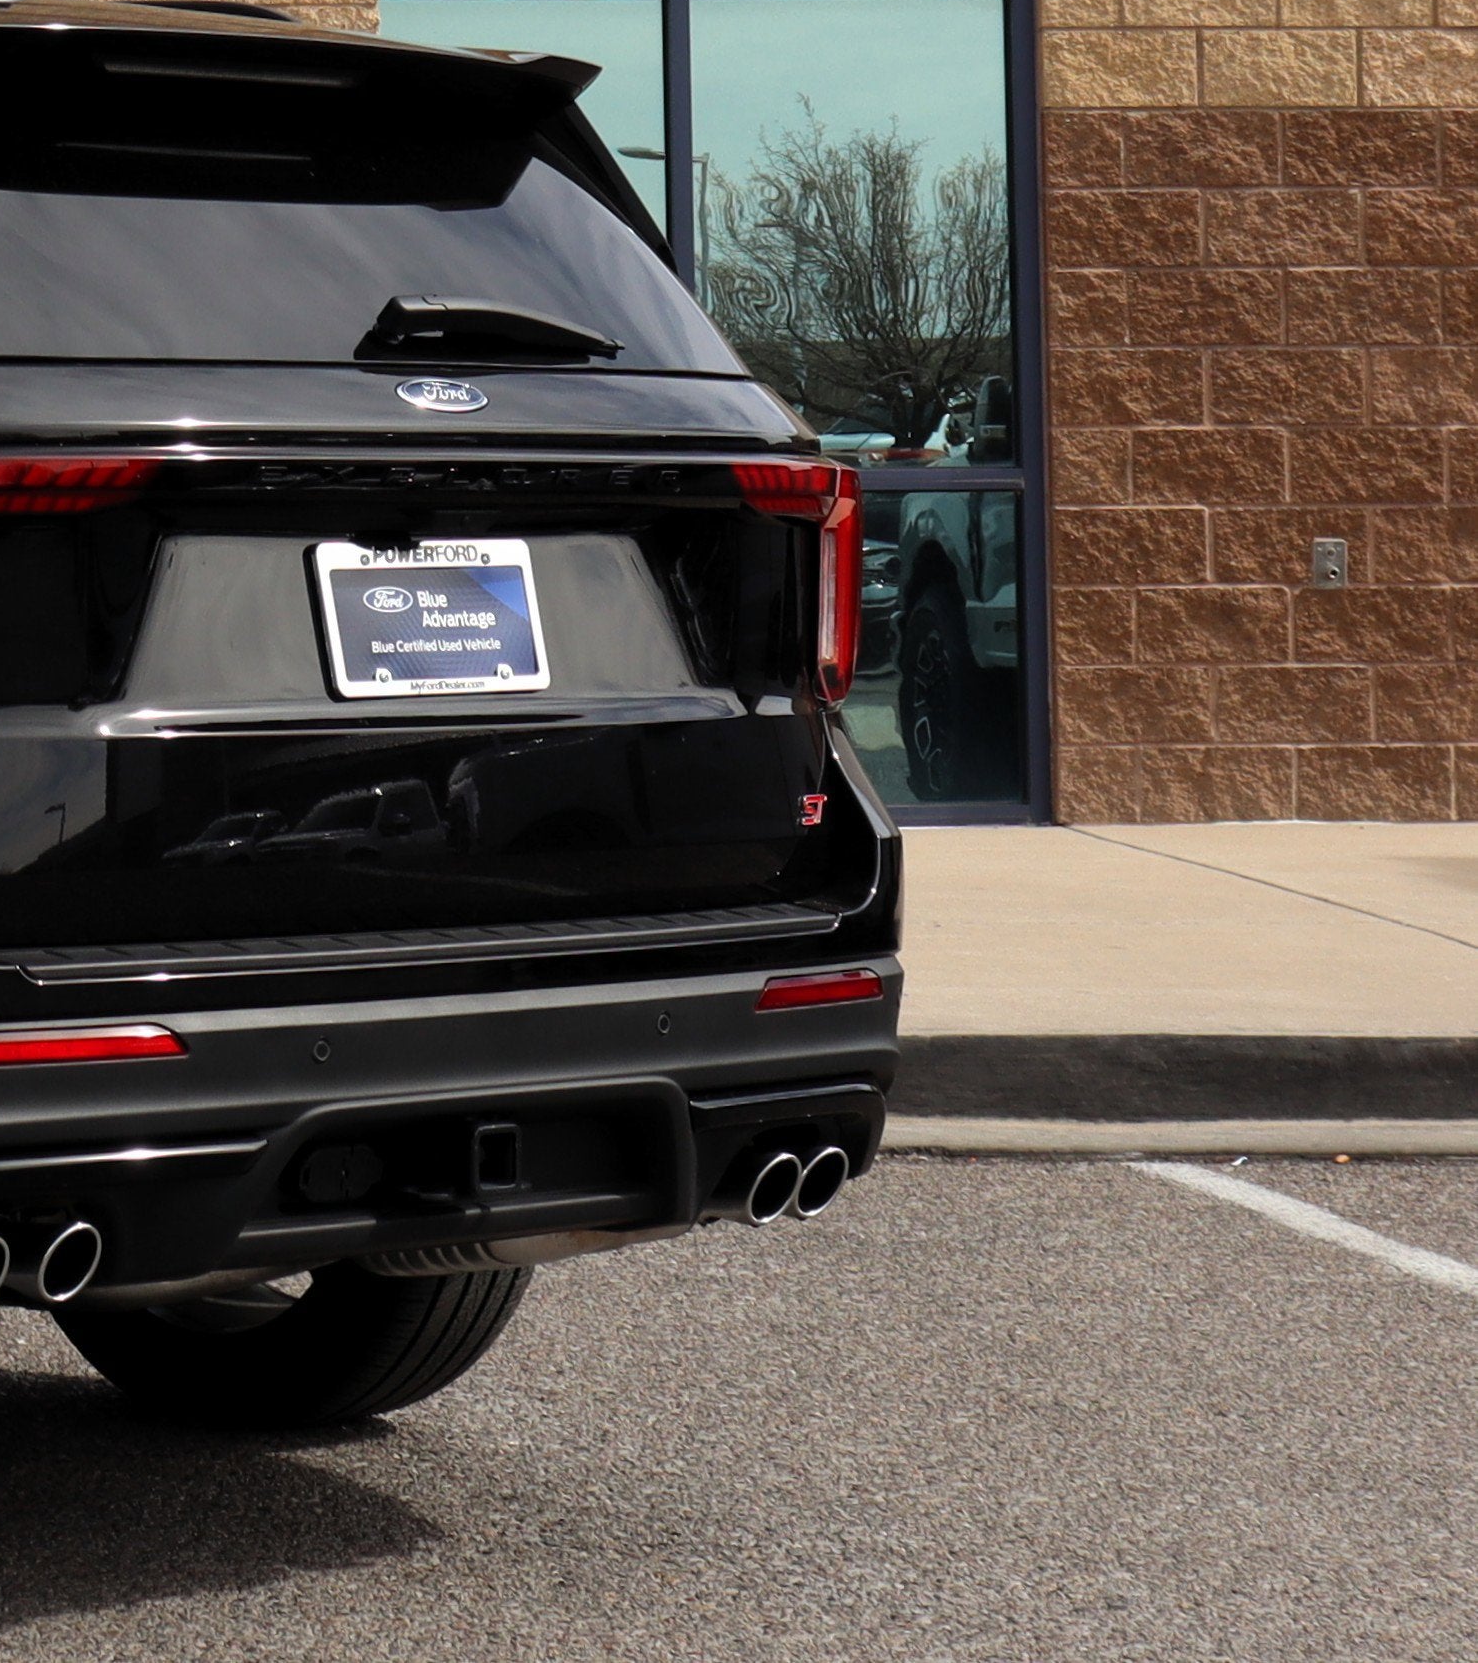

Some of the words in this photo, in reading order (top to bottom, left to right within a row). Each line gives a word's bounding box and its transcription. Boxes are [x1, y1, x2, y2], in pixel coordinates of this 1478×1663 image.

[423, 382, 471, 401] Ford
[372, 544, 478, 564] POWERFORD
[373, 590, 404, 608] Ford
[417, 590, 448, 608] Blue
[422, 610, 496, 629] Advantage
[371, 640, 395, 654] Blue
[396, 639, 437, 652] Certified
[438, 638, 463, 652] Used
[463, 637, 502, 651] Vehicle
[410, 680, 486, 695] MyFordDealer.com
